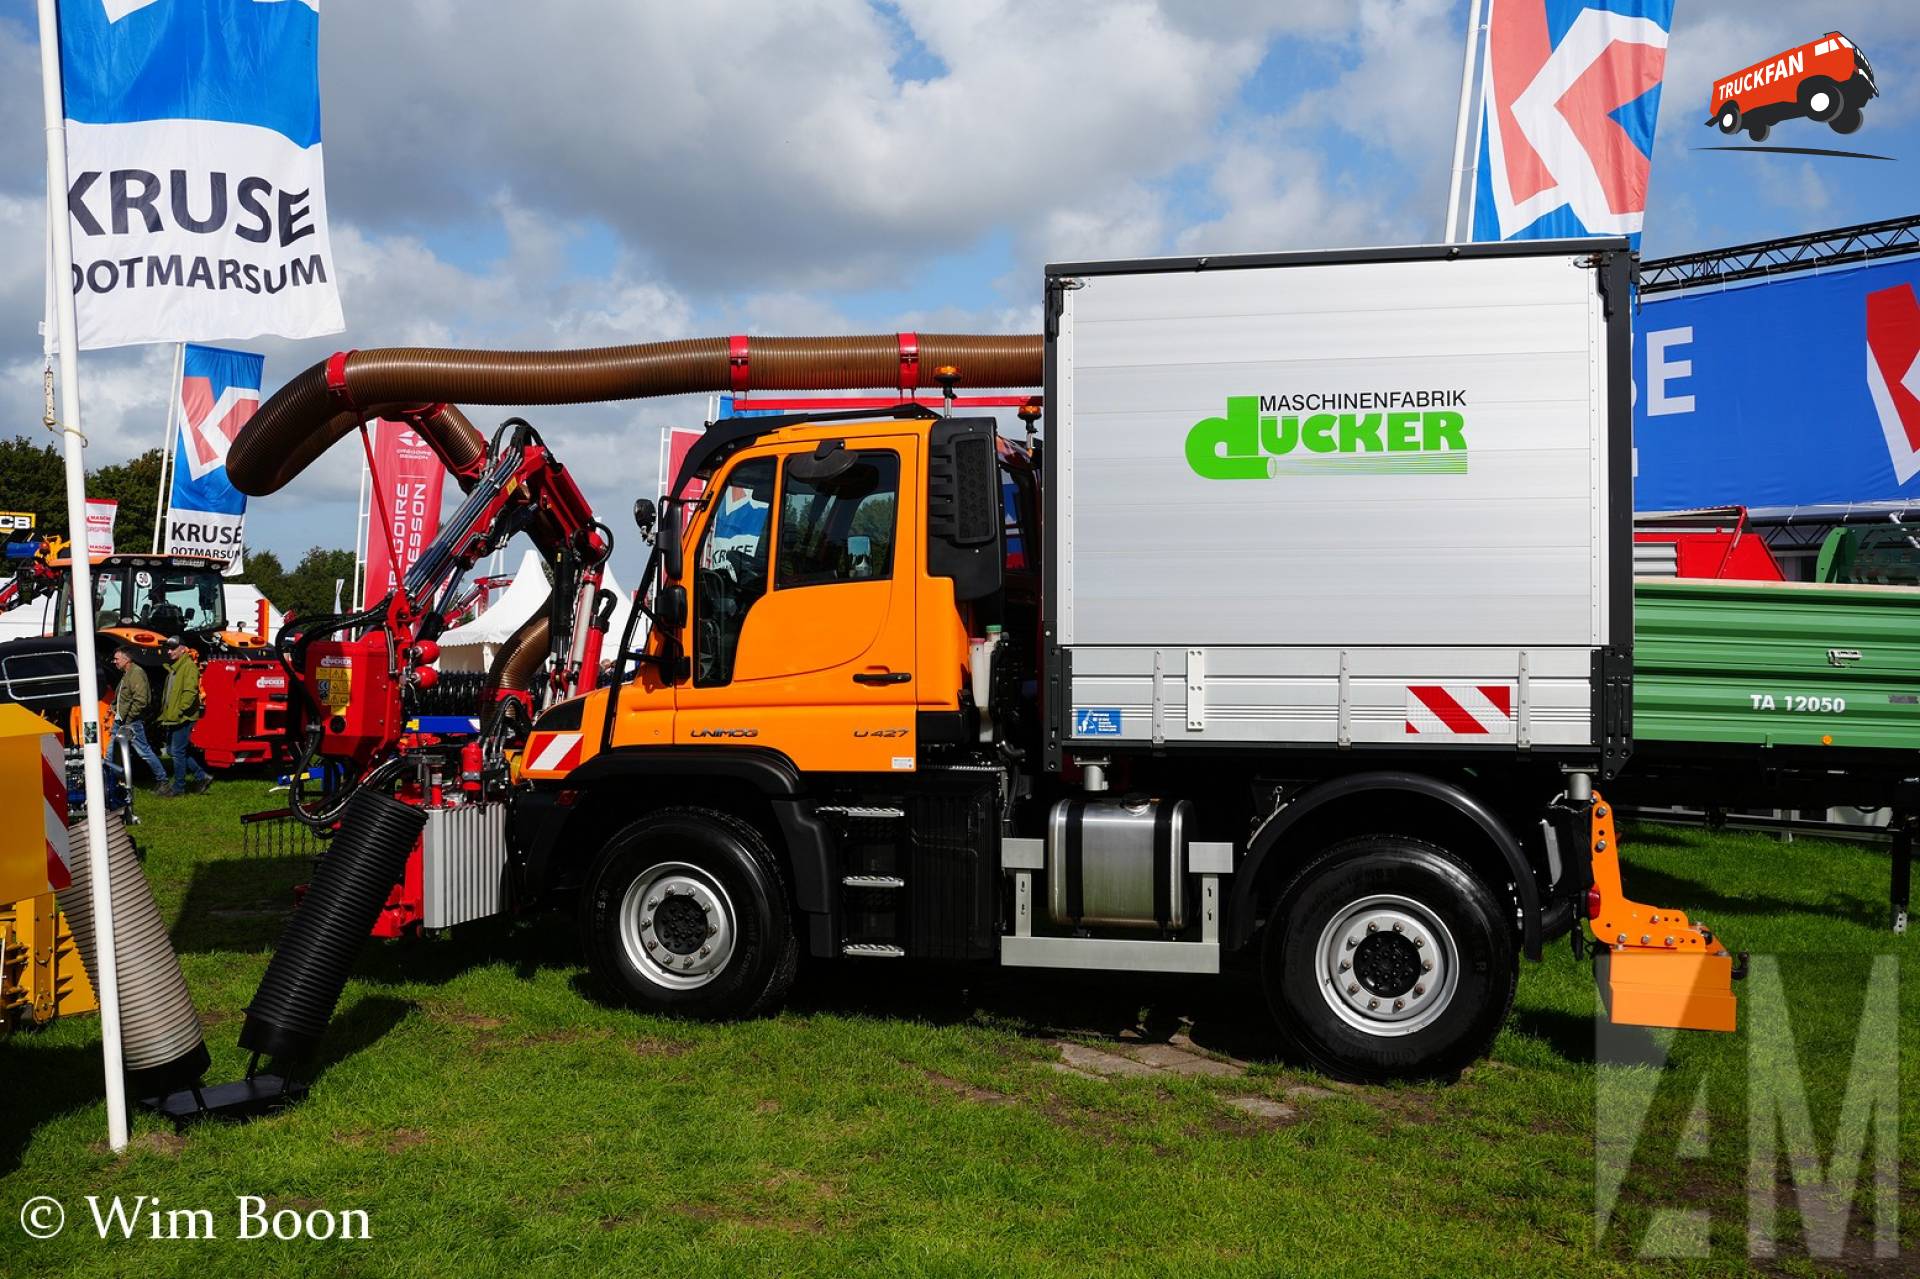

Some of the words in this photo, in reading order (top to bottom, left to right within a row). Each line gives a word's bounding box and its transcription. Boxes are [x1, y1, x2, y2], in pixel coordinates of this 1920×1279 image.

[1260, 389, 1467, 412] MASCHINENFABRIK
[171, 521, 243, 545] KRUSE
[405, 483, 427, 572] ESSON
[1750, 694, 1775, 711] TA
[1783, 695, 1846, 714] 12050
[690, 728, 759, 739] UNIMOG
[853, 729, 869, 738] U
[869, 728, 910, 738] 427
